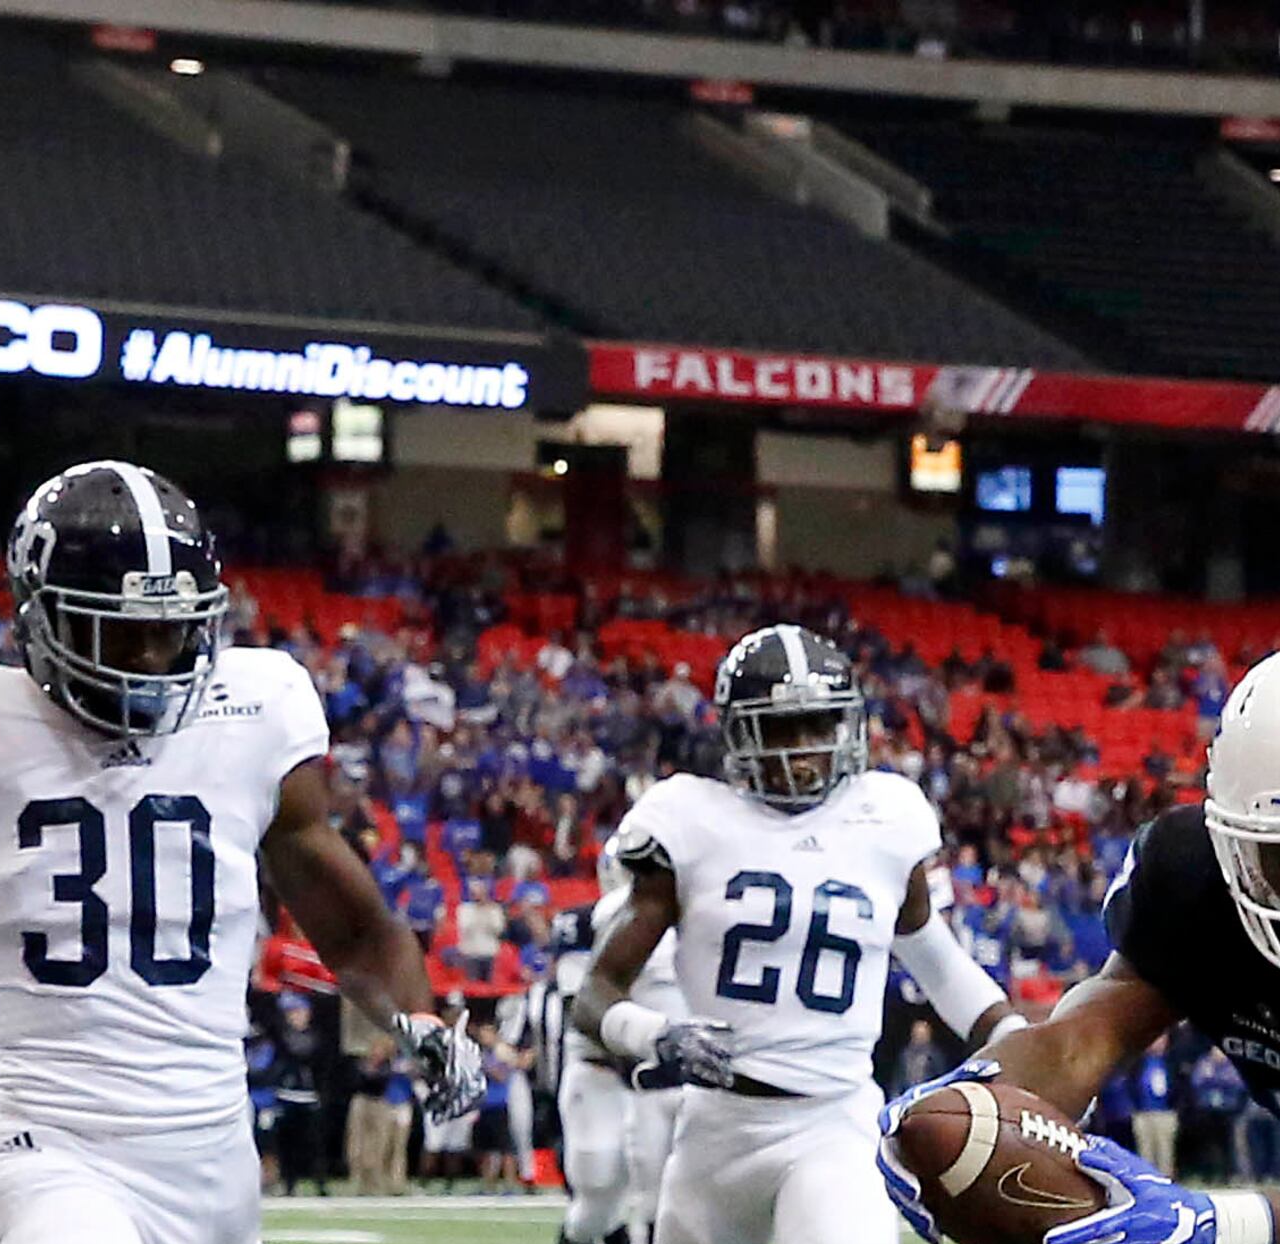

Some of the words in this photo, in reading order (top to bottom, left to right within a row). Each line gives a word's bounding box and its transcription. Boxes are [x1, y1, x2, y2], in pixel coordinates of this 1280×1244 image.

[121, 329, 528, 409] #AlumniDiscount
[633, 350, 916, 406] FALCONS
[17, 793, 216, 988] 30
[717, 870, 874, 1015] 26
